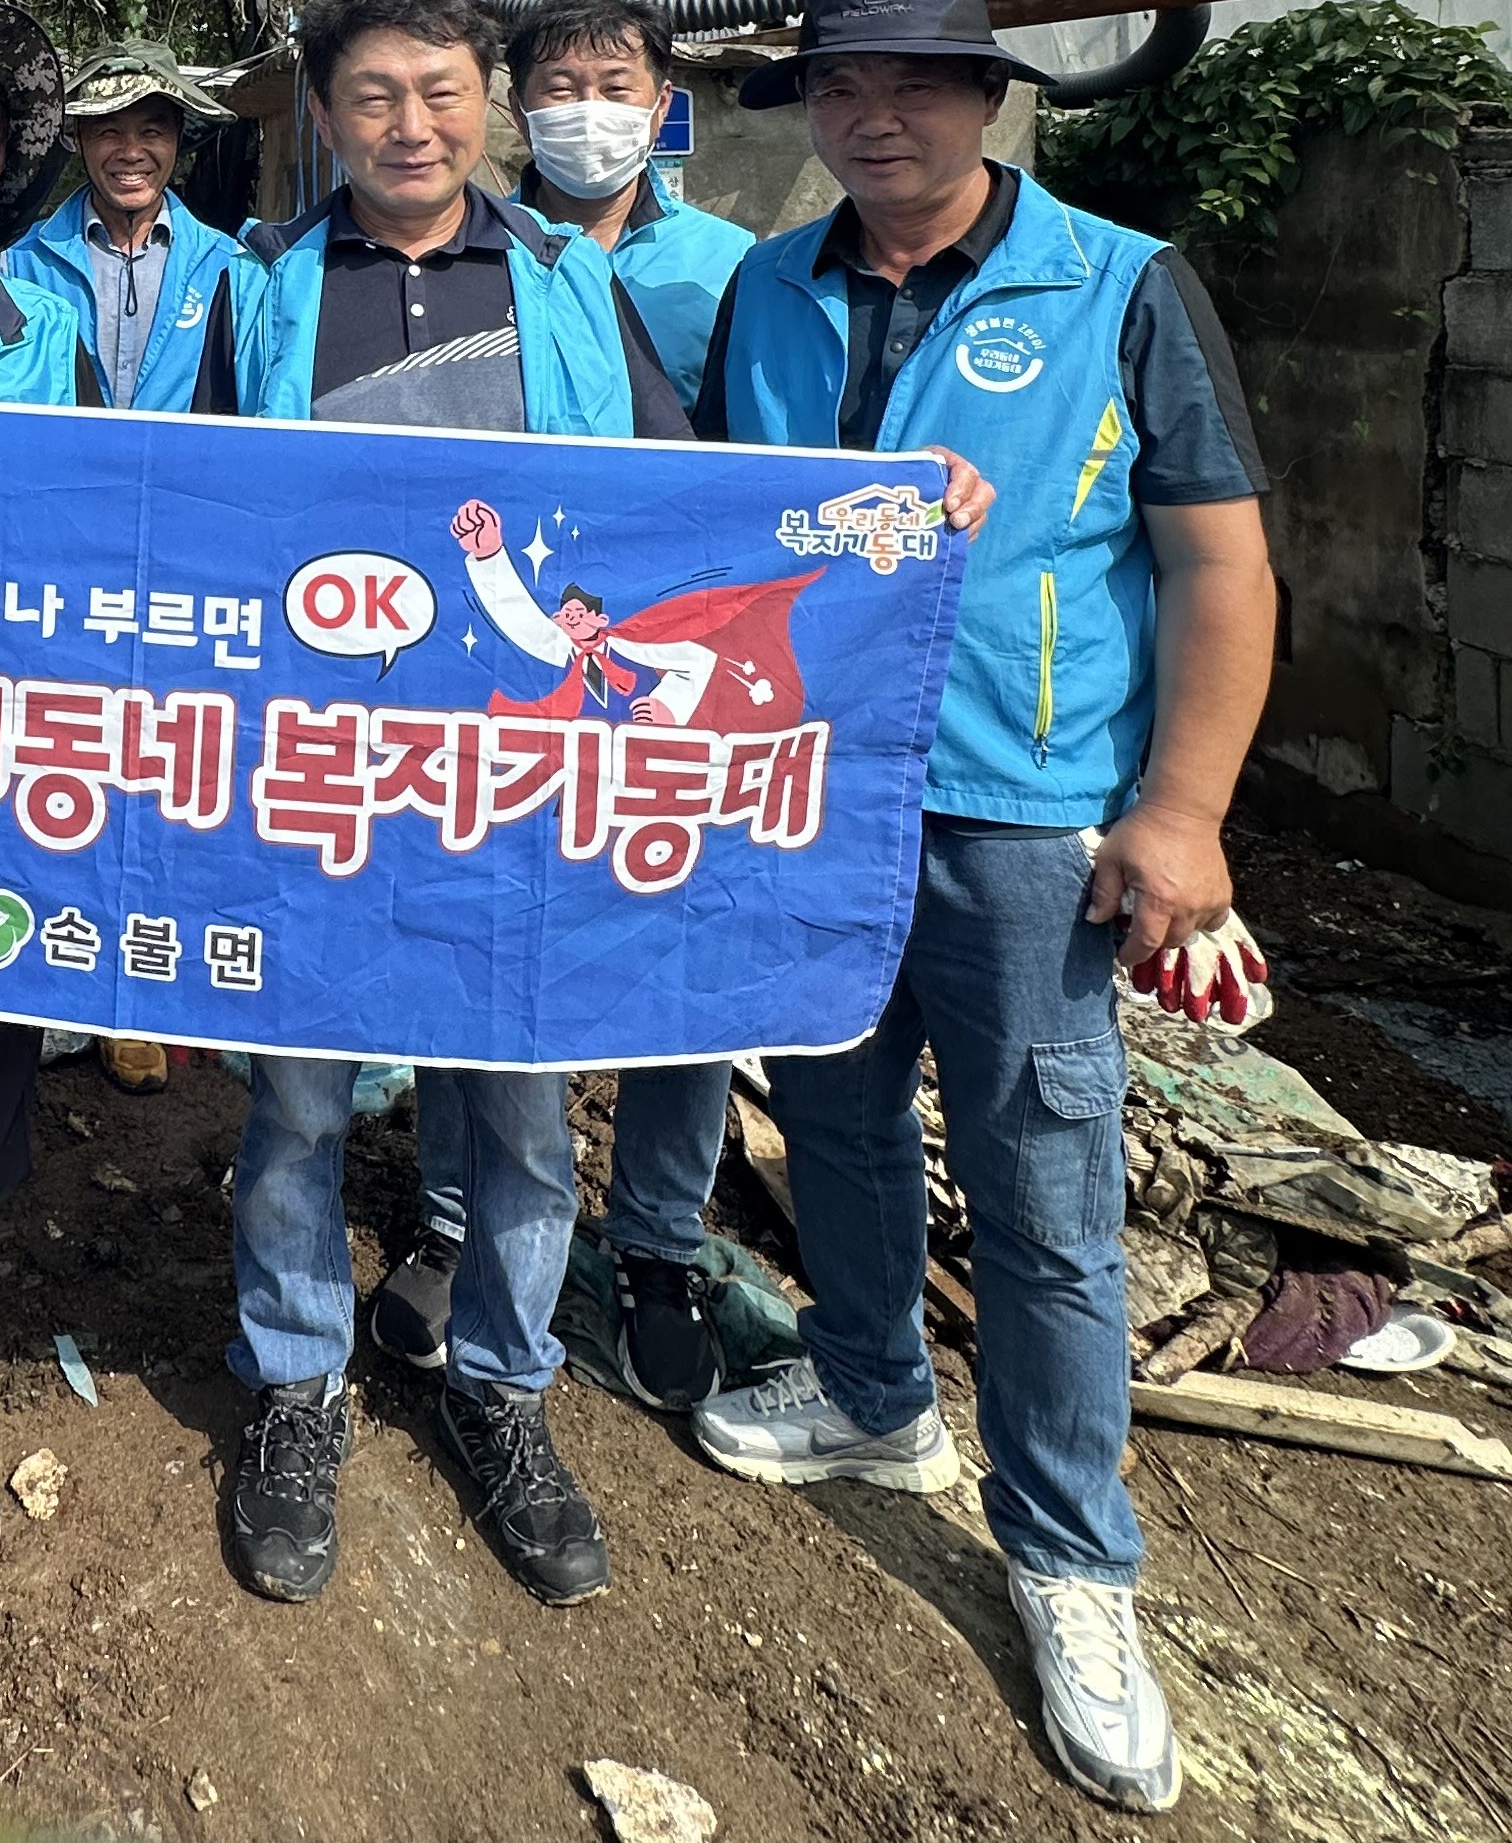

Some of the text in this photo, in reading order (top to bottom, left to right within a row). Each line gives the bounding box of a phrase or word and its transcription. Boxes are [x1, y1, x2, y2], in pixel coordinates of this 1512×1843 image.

[780, 512, 934, 572] 복지기동대
[834, 506, 921, 533] 우리동네
[84, 586, 263, 670] 부르면
[302, 573, 410, 630] OK
[262, 707, 816, 885] 복지기동대
